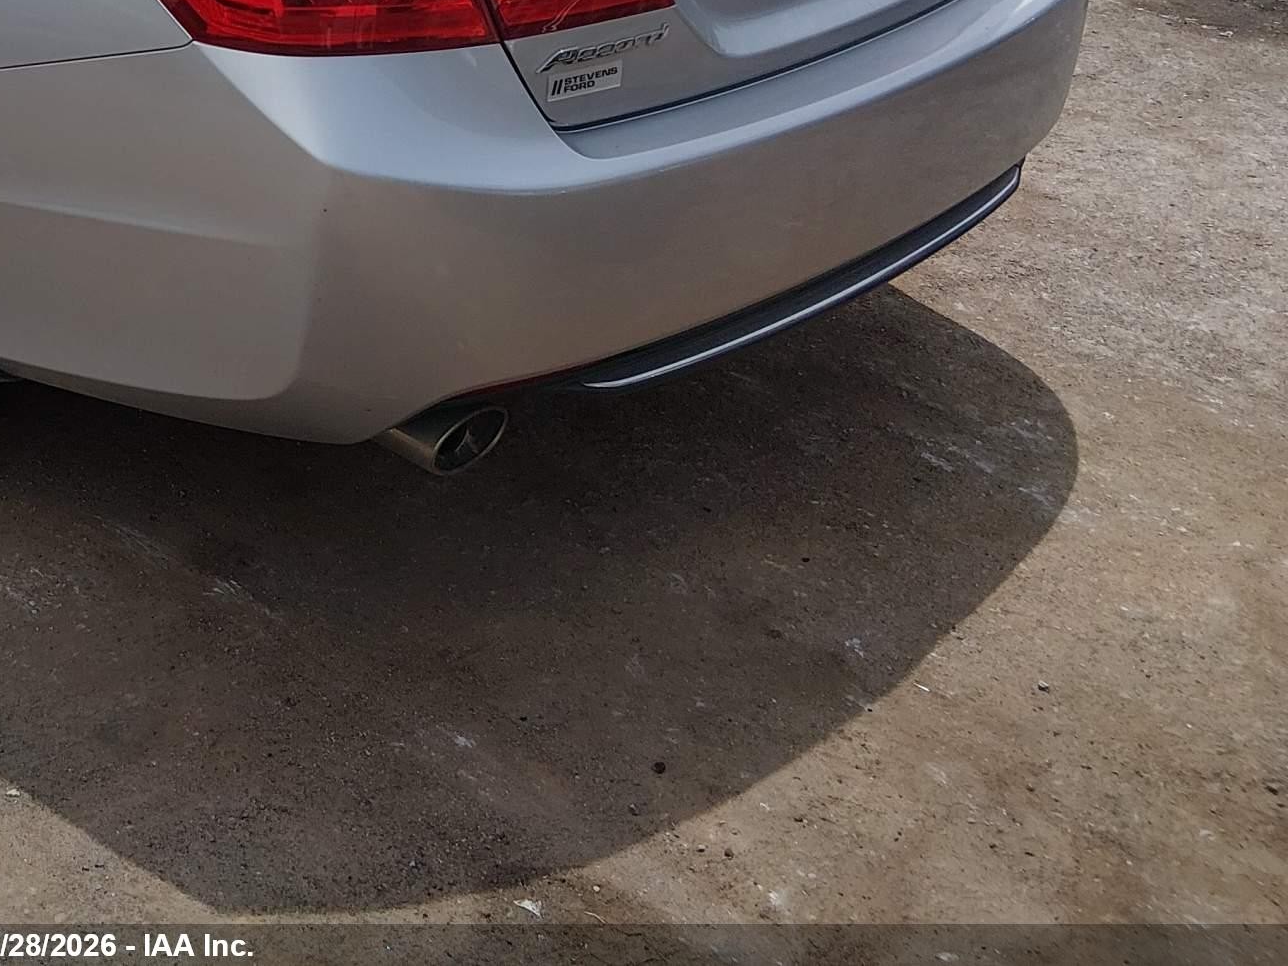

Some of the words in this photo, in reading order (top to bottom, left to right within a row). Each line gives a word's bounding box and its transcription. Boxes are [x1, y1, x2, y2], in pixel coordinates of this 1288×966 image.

[535, 22, 670, 74] Accord
[563, 66, 618, 85] STEVENS
[563, 79, 596, 93] FORD
